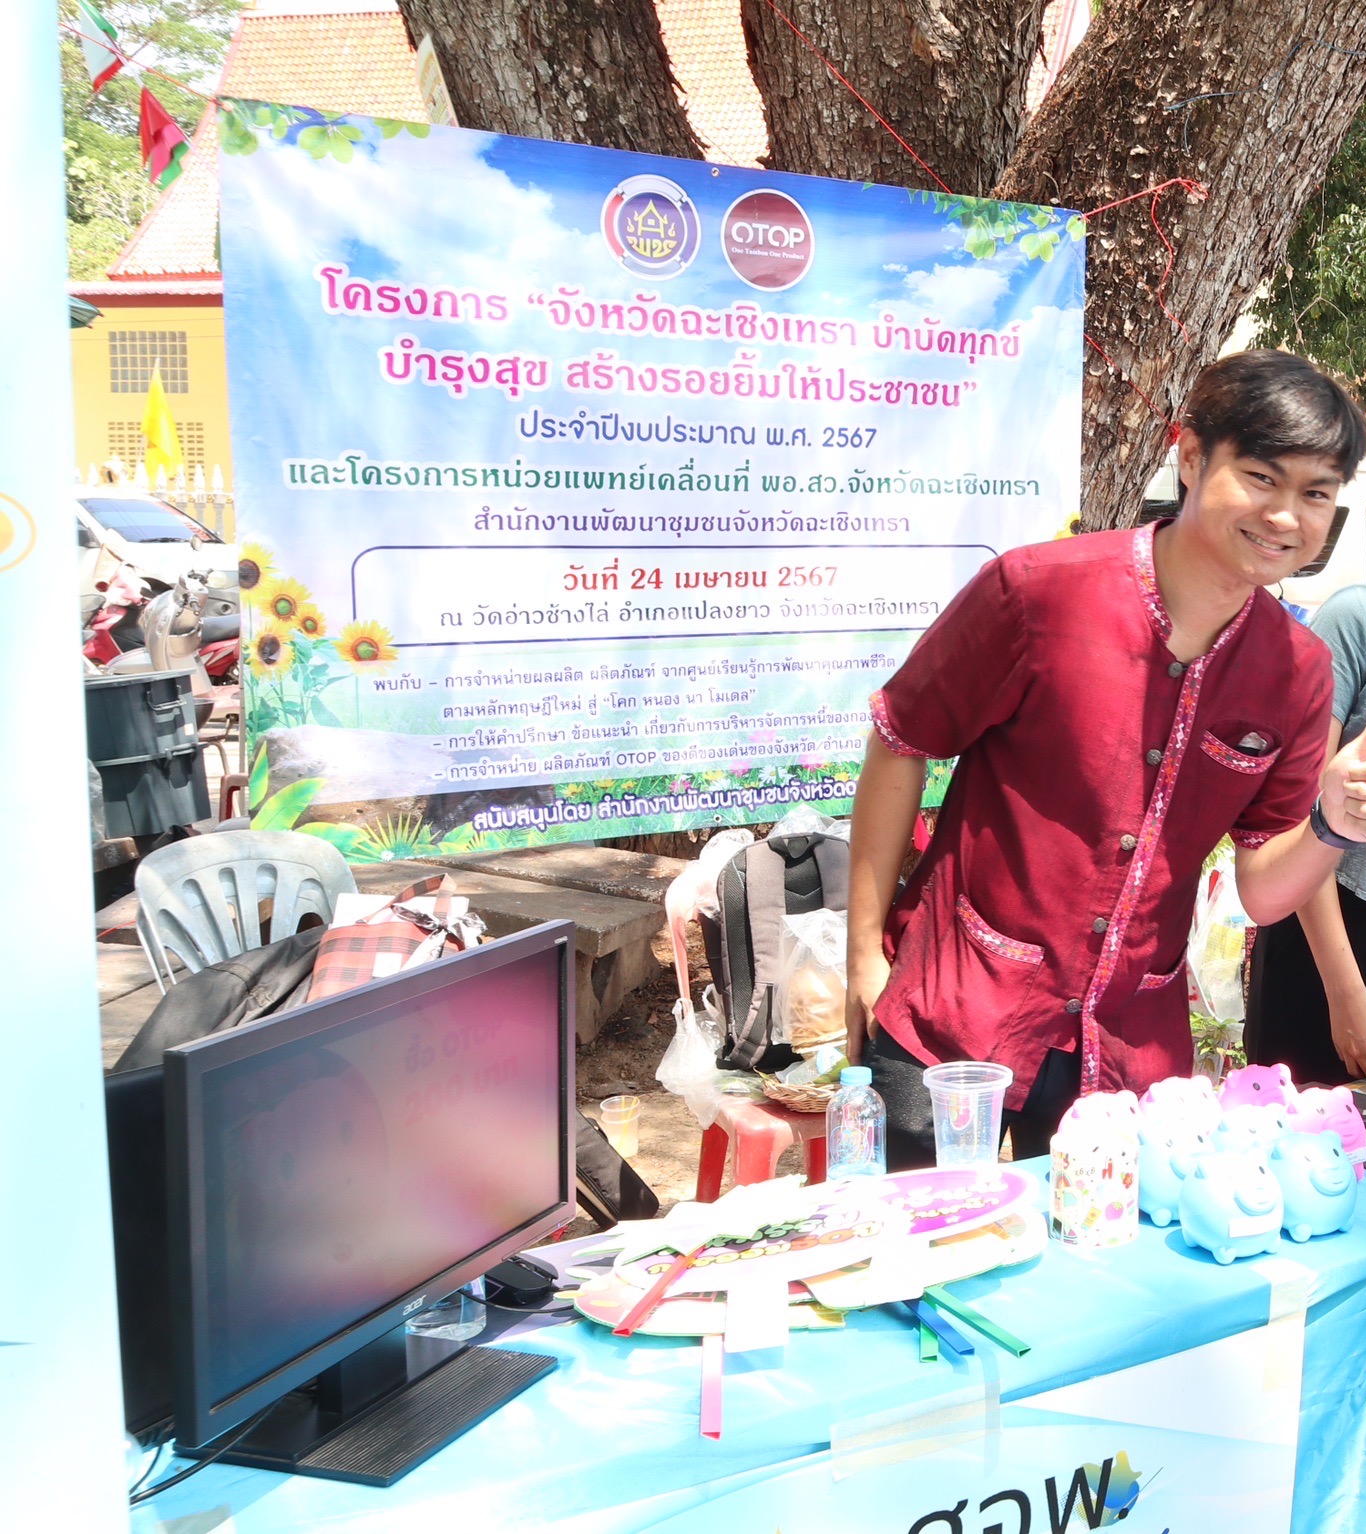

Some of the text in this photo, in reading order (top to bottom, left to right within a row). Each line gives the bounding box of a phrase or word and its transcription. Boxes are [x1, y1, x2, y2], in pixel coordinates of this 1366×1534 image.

[731, 221, 805, 248] OTOP
[745, 248, 768, 257] Tambon
[782, 252, 804, 260] Product
[320, 267, 1020, 364] โครงการ “จังหวัดฉะเชิงเทรา บำบัดทุกข์
[385, 338, 978, 408] บำรุงสุข สร้างรอยยิ้มให้ประชาชน”
[520, 410, 877, 449] ประจำปีงบประมาณ พ.ศ. 2567
[289, 456, 1041, 496] และโครงการหน่วยแพทย์เคลื่อนที่ พอ.สว.จังหวัดฉะเชิงเทรา
[474, 505, 911, 538] สำนักงานพัฒนาชุมชนจังหวัดฉะเชิงเทรา
[563, 558, 839, 591] วันที่ 24 เมษายน 2567
[440, 597, 940, 627] ณ วัดอ่าวช้างไล่ อำเภอแปลงยาว จังหวัดฉะเชิงเทรา
[374, 672, 422, 692] พบกับ
[445, 665, 583, 688] การจำหน่ายผลผลิต
[590, 662, 656, 681] ผลิตภัณฑ์
[661, 653, 896, 682] จากศูนย์เรียนรู้การพัฒนาคุณภาพชีวิต
[588, 694, 597, 716] สู่
[643, 694, 680, 707] หนอง
[686, 693, 703, 704] นา
[449, 727, 566, 749] การให้คำปรึกษา
[571, 721, 639, 741] ข้อแนะนำ
[450, 758, 537, 779] การจำหน่าย
[544, 751, 611, 772] ผลิตภัณฑ์
[617, 752, 656, 766] OTOP
[473, 801, 592, 833] สนับสนุนโดย
[403, 1294, 427, 1316] acer
